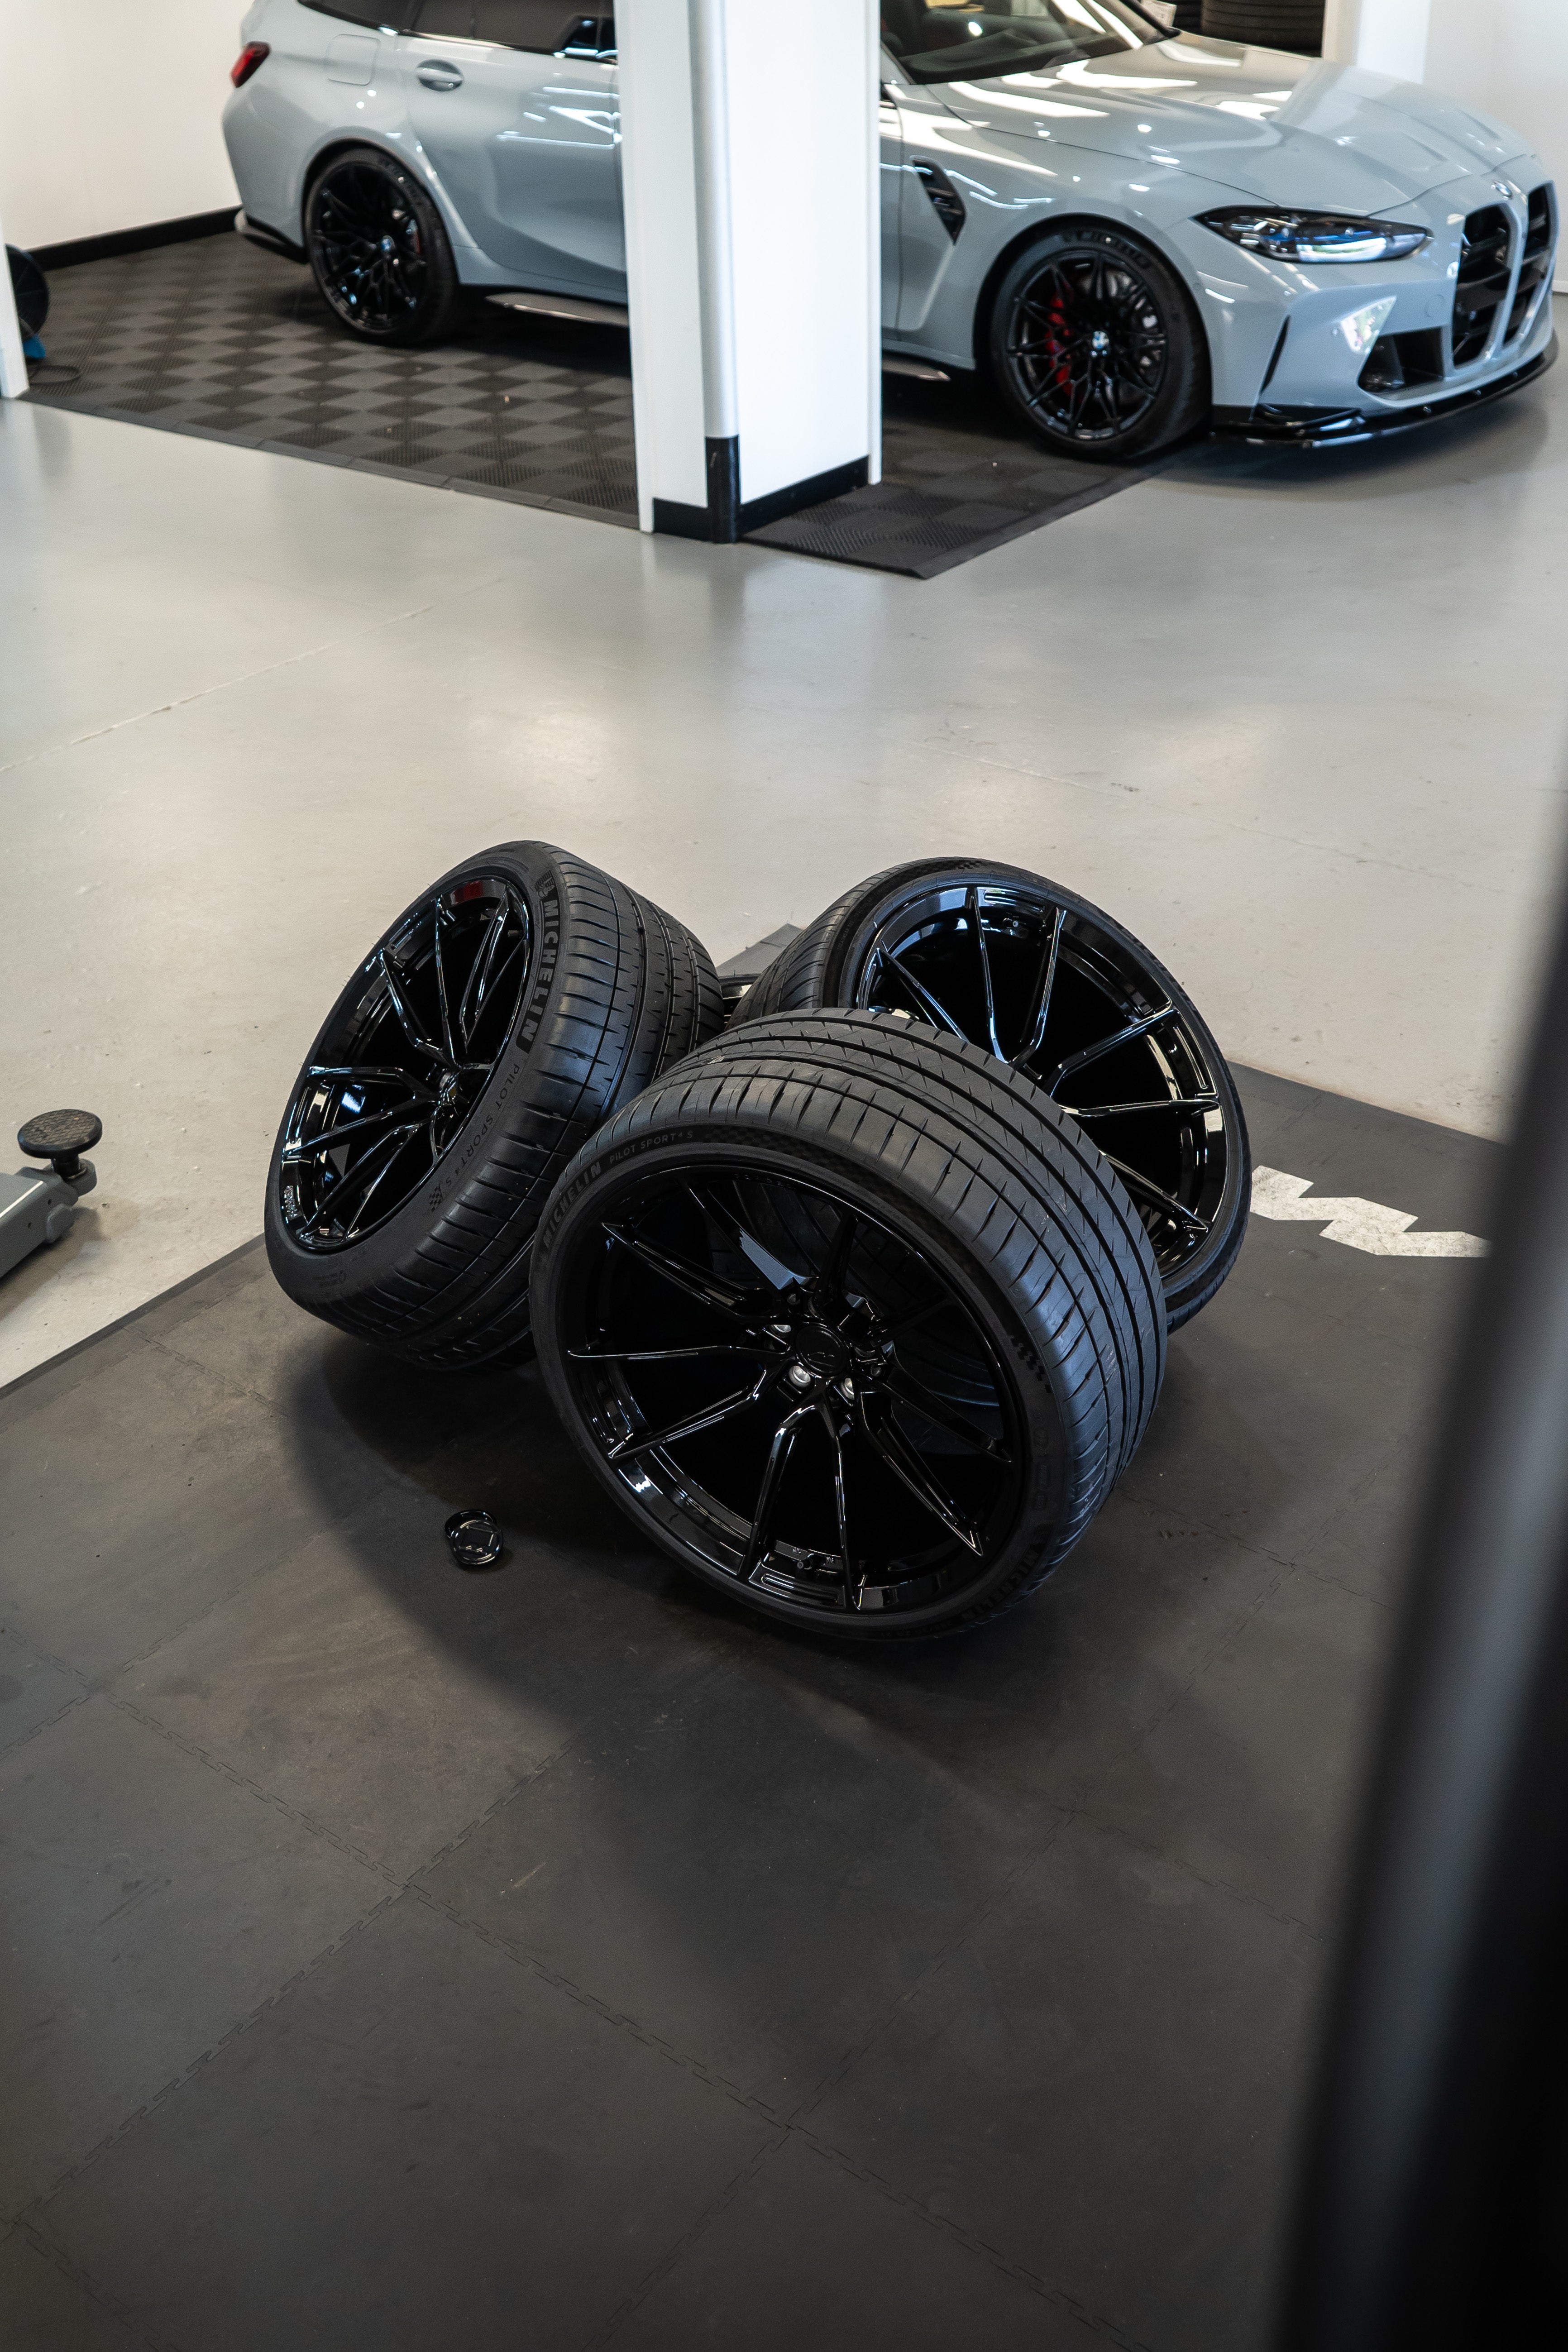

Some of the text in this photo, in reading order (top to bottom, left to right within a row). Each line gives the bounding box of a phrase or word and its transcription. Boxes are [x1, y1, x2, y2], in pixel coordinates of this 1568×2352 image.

[521, 899, 559, 1042] MICHELIN
[495, 1063, 520, 1109] PILOT
[461, 1114, 493, 1168] SPORT
[446, 1176, 452, 1187] S
[543, 1162, 602, 1248] MICHELIN
[610, 1146, 635, 1164] PILOT
[641, 1133, 676, 1149] SPORT
